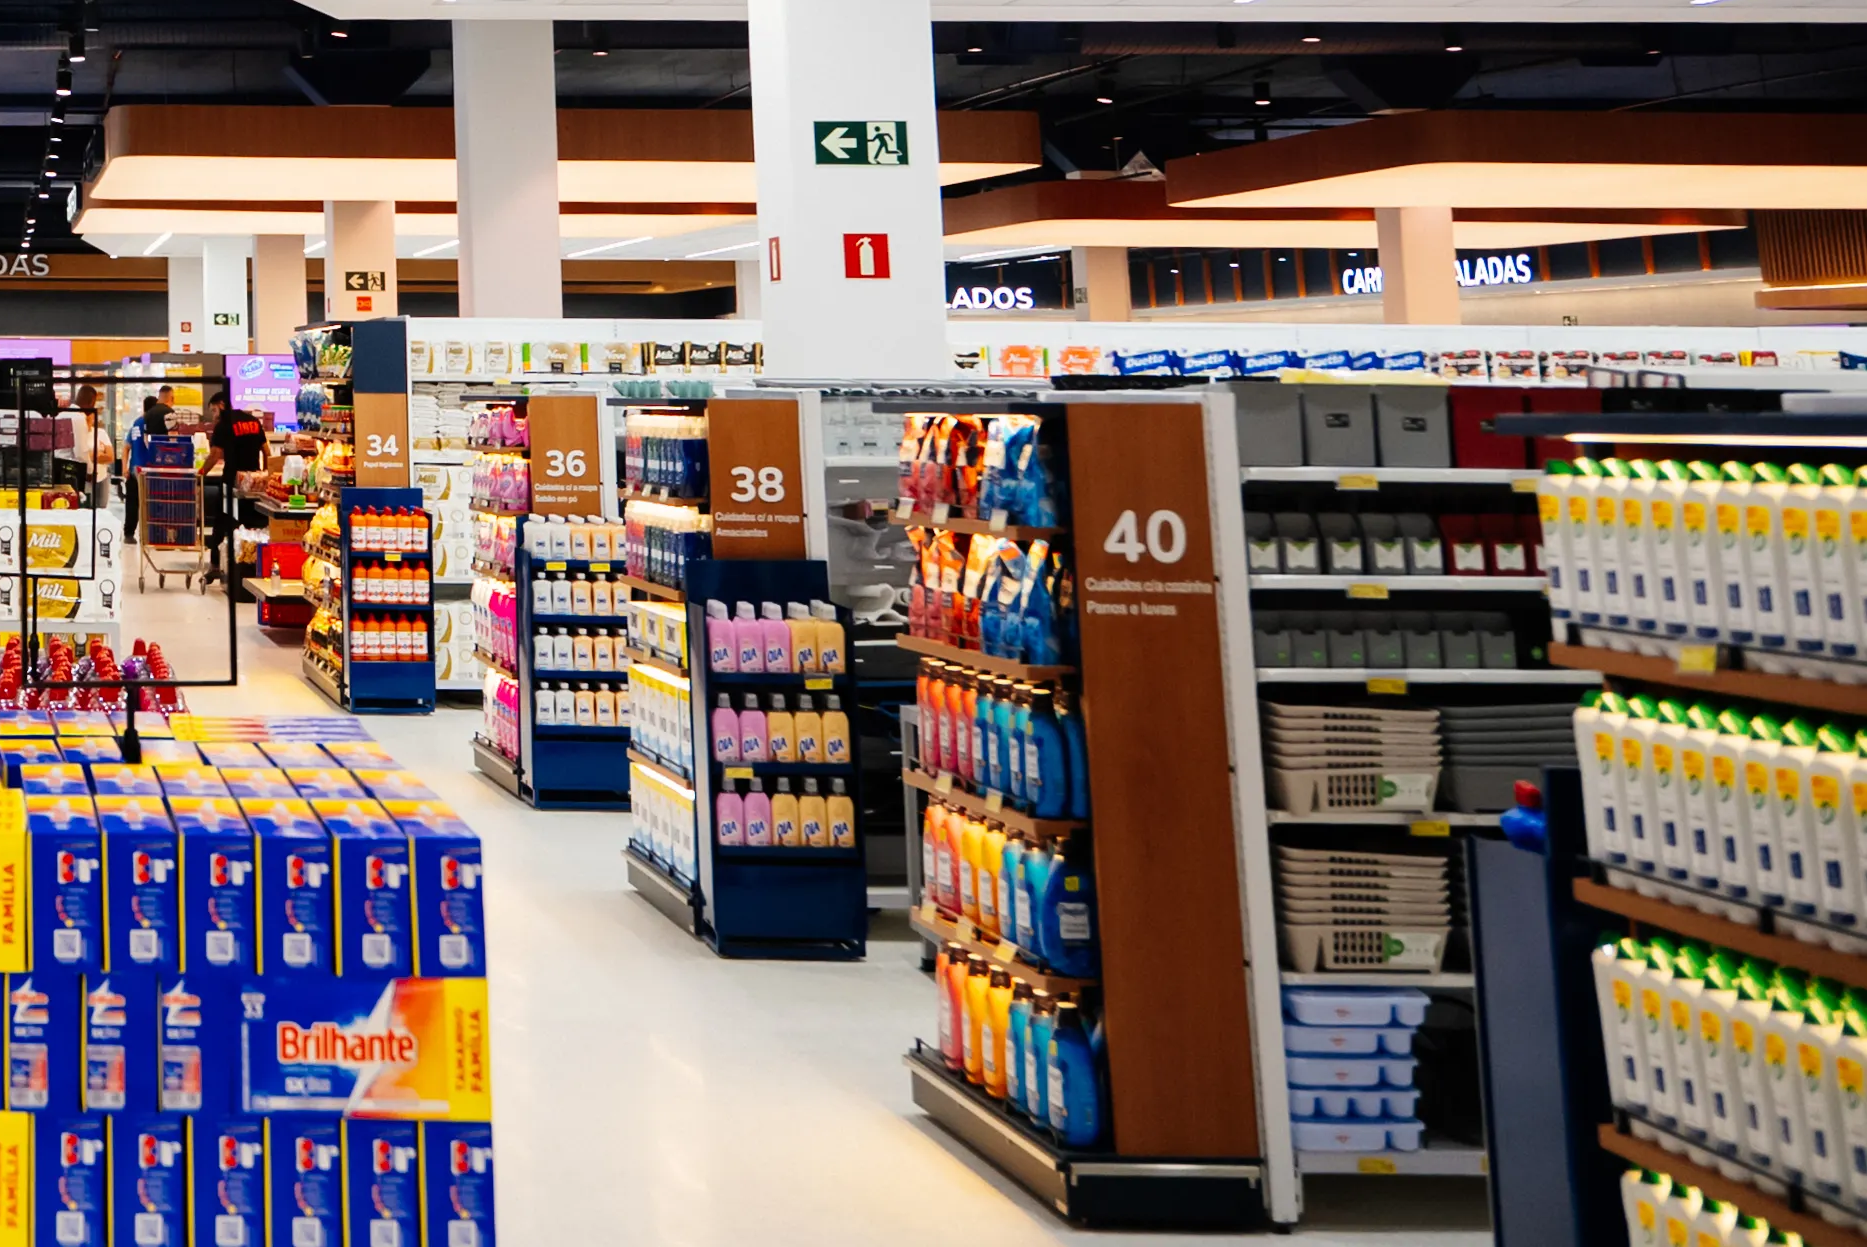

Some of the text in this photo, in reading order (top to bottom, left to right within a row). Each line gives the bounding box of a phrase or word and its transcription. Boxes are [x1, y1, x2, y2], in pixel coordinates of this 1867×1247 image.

[1454, 253, 1532, 287] ALADAS
[944, 286, 1034, 309] ADOS
[1125, 353, 1166, 369] Duetto
[1184, 353, 1225, 369] Duetto
[1245, 354, 1285, 368] Duetto
[1305, 355, 1345, 369] Duetto
[366, 434, 399, 456] 34
[545, 449, 586, 477] 36
[730, 466, 785, 502] 38
[27, 533, 62, 549] Mili
[1103, 509, 1187, 564] 40
[1086, 600, 1128, 615] Panos
[1140, 602, 1177, 616] luvas
[3, 863, 16, 945] FAMÍLIA
[279, 1025, 415, 1062] Brilhante
